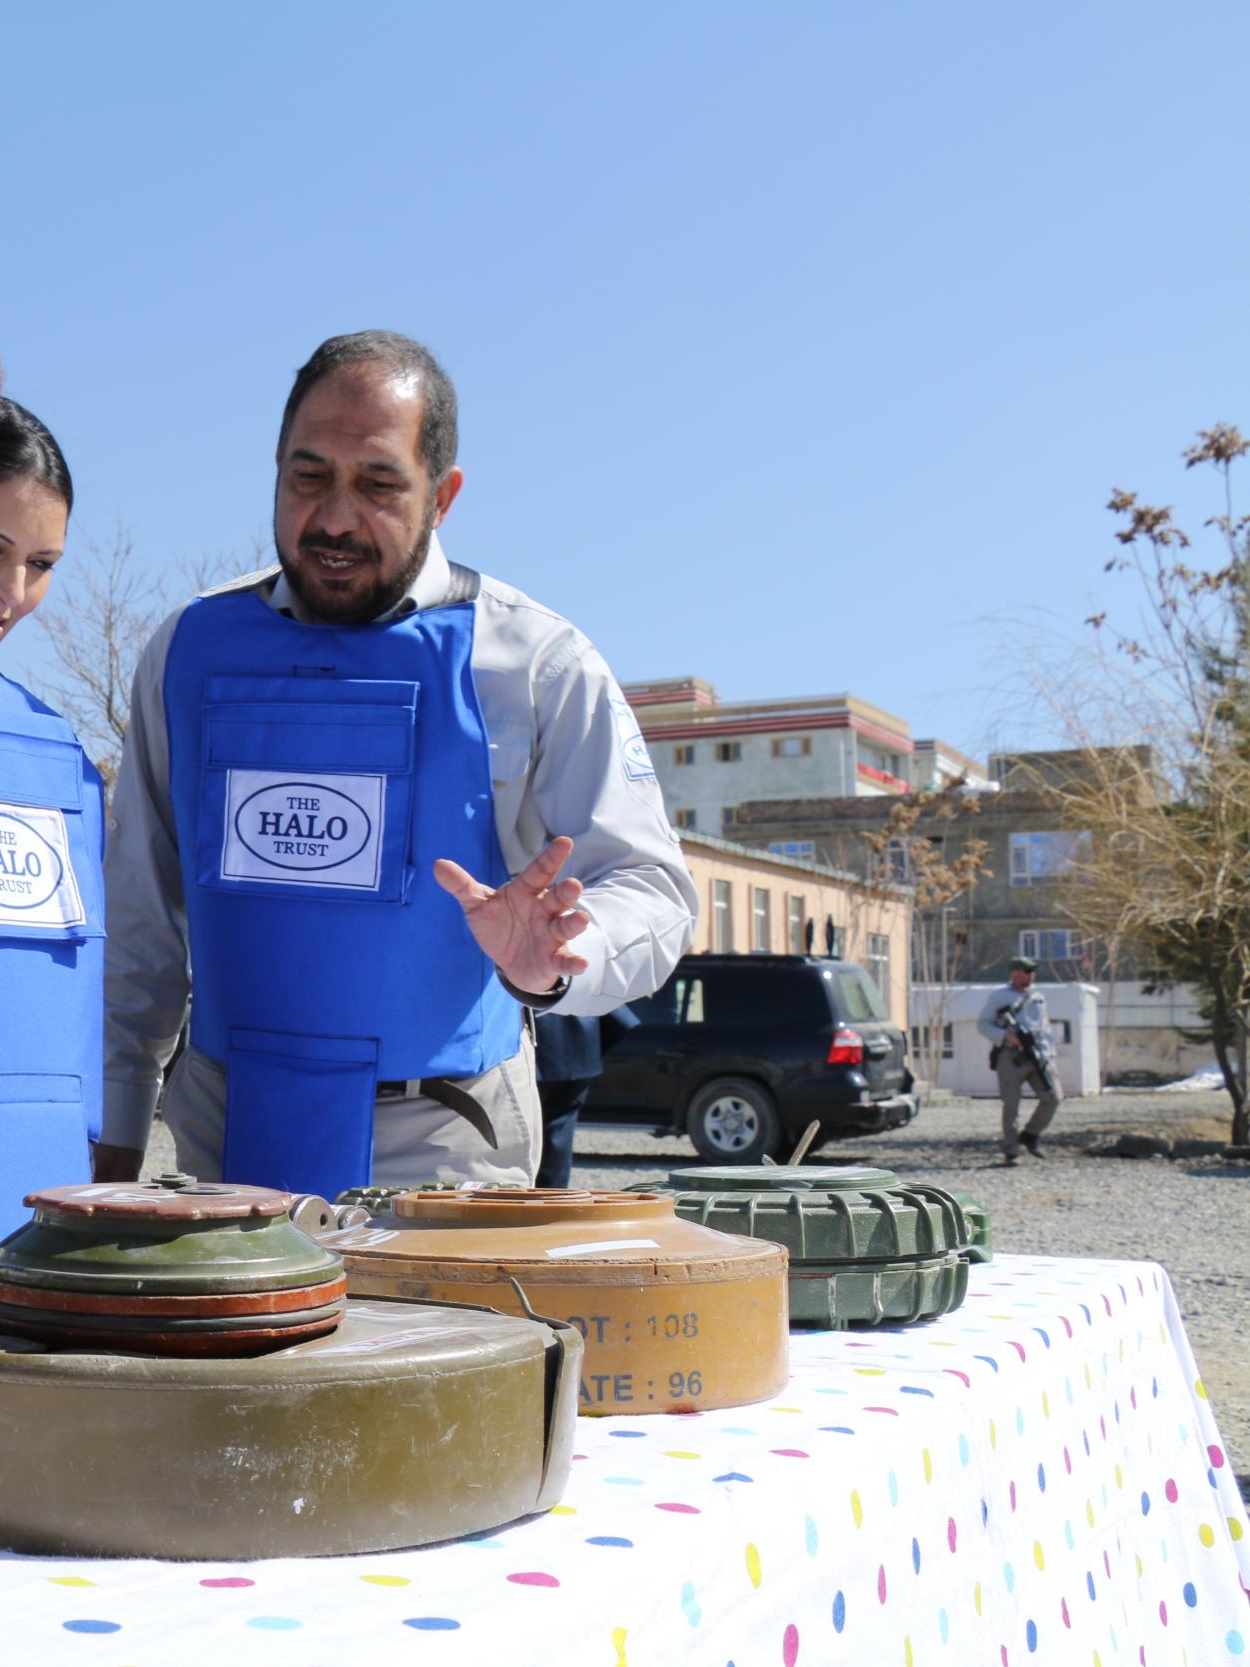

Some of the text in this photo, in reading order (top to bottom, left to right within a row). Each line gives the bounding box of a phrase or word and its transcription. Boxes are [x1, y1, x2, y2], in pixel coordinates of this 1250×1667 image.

[286, 797, 320, 811] THE
[258, 811, 348, 841] HALO
[273, 841, 329, 857] TRUST
[567, 1316, 610, 1343] OT
[647, 1313, 699, 1338] 108
[579, 1375, 634, 1404] ATE
[668, 1371, 703, 1398] 96
